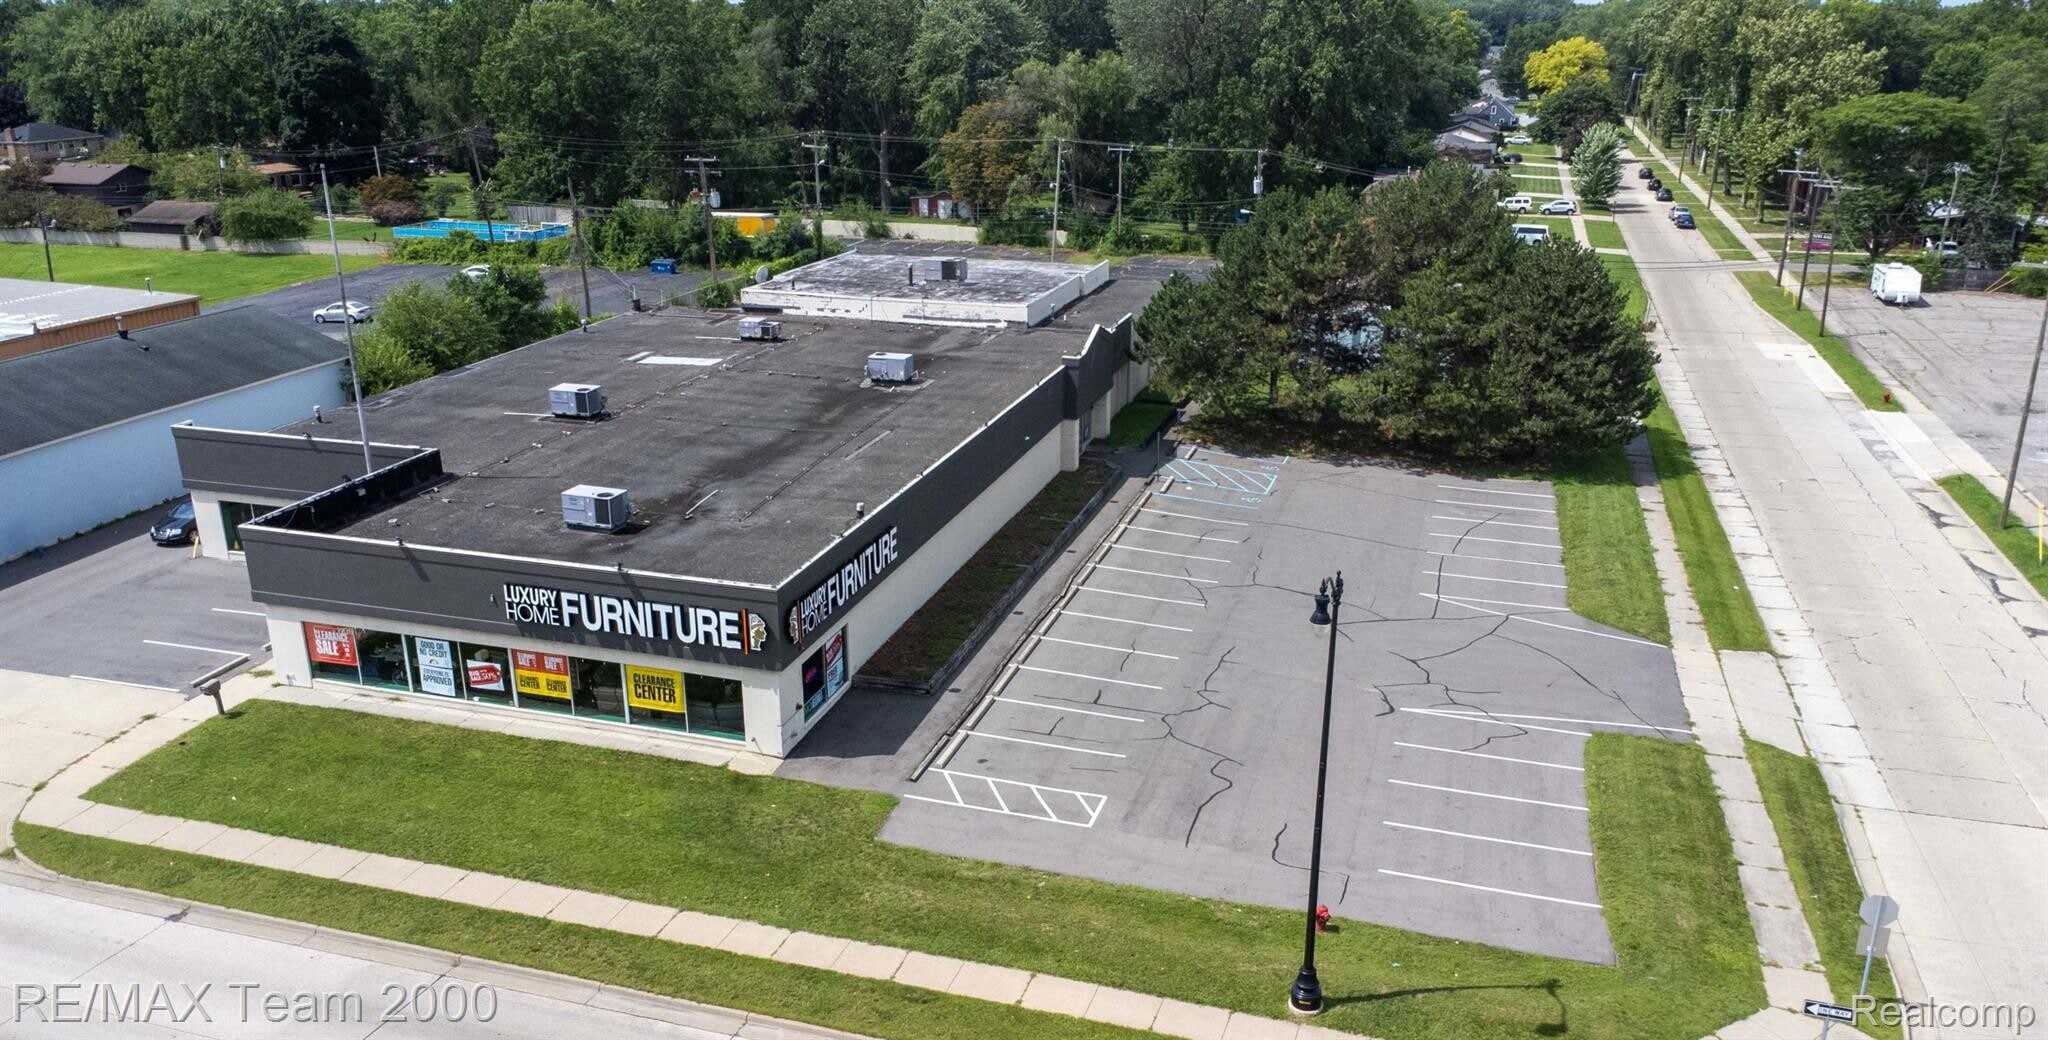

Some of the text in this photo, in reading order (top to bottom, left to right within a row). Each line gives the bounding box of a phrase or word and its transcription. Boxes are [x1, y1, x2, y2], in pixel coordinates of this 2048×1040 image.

[826, 526, 899, 615] FURNITURE
[503, 584, 557, 607] LUXURY
[800, 582, 827, 619] LUXURY
[505, 602, 560, 626] HOME
[560, 591, 742, 650] FURNITURE
[801, 600, 829, 637] HOME
[313, 628, 348, 643] CLEARANCE
[315, 639, 339, 657] SALE
[419, 647, 447, 658] NO CREDIT
[420, 640, 444, 650] GOOD OR
[423, 674, 452, 686] APPROVED
[520, 679, 540, 690] CENTER
[547, 683, 567, 693] CENTER
[633, 673, 675, 689] CLEARANCE
[634, 683, 676, 704] CENTER
